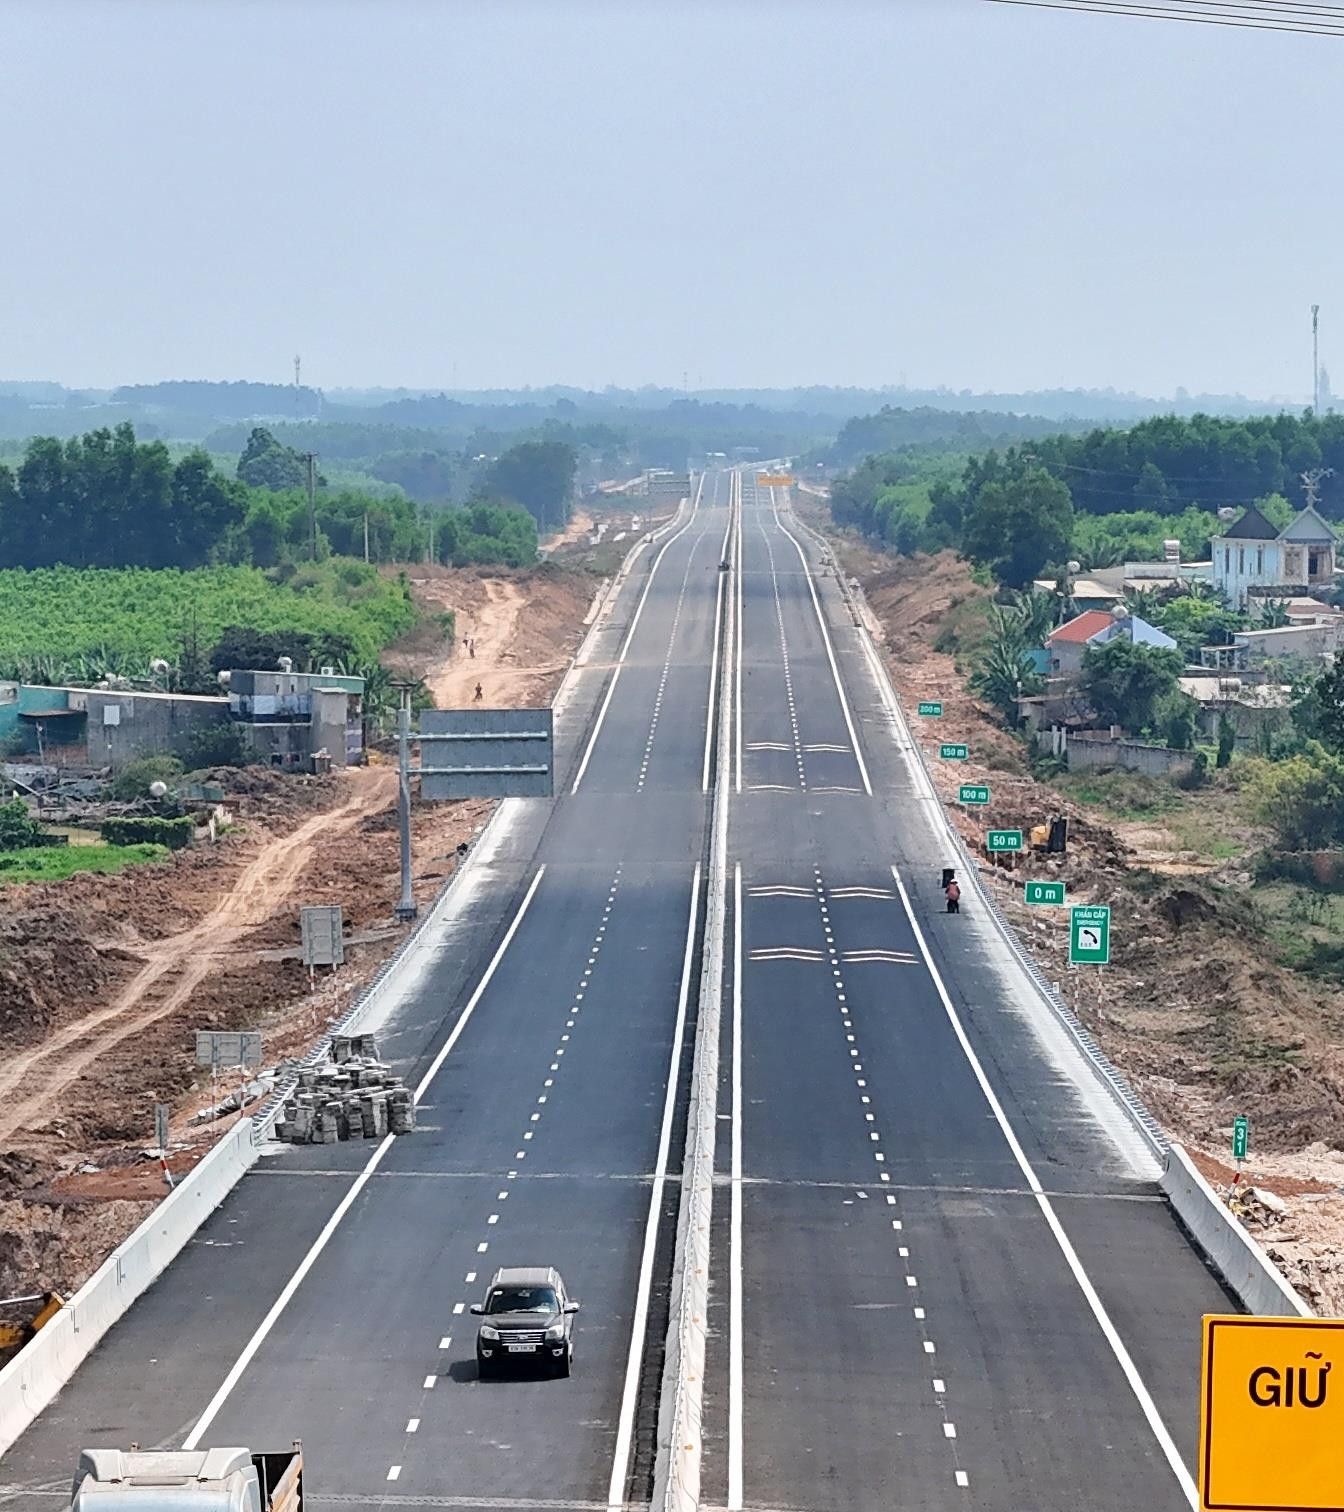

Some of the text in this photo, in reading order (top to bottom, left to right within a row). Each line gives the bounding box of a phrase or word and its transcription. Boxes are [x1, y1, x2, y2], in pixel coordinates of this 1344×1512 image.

[943, 748, 956, 756] 150
[962, 790, 976, 799] 100
[993, 836, 1017, 846] 50 m
[1035, 888, 1056, 899] 0 m
[1248, 1351, 1331, 1408] GIỮ
